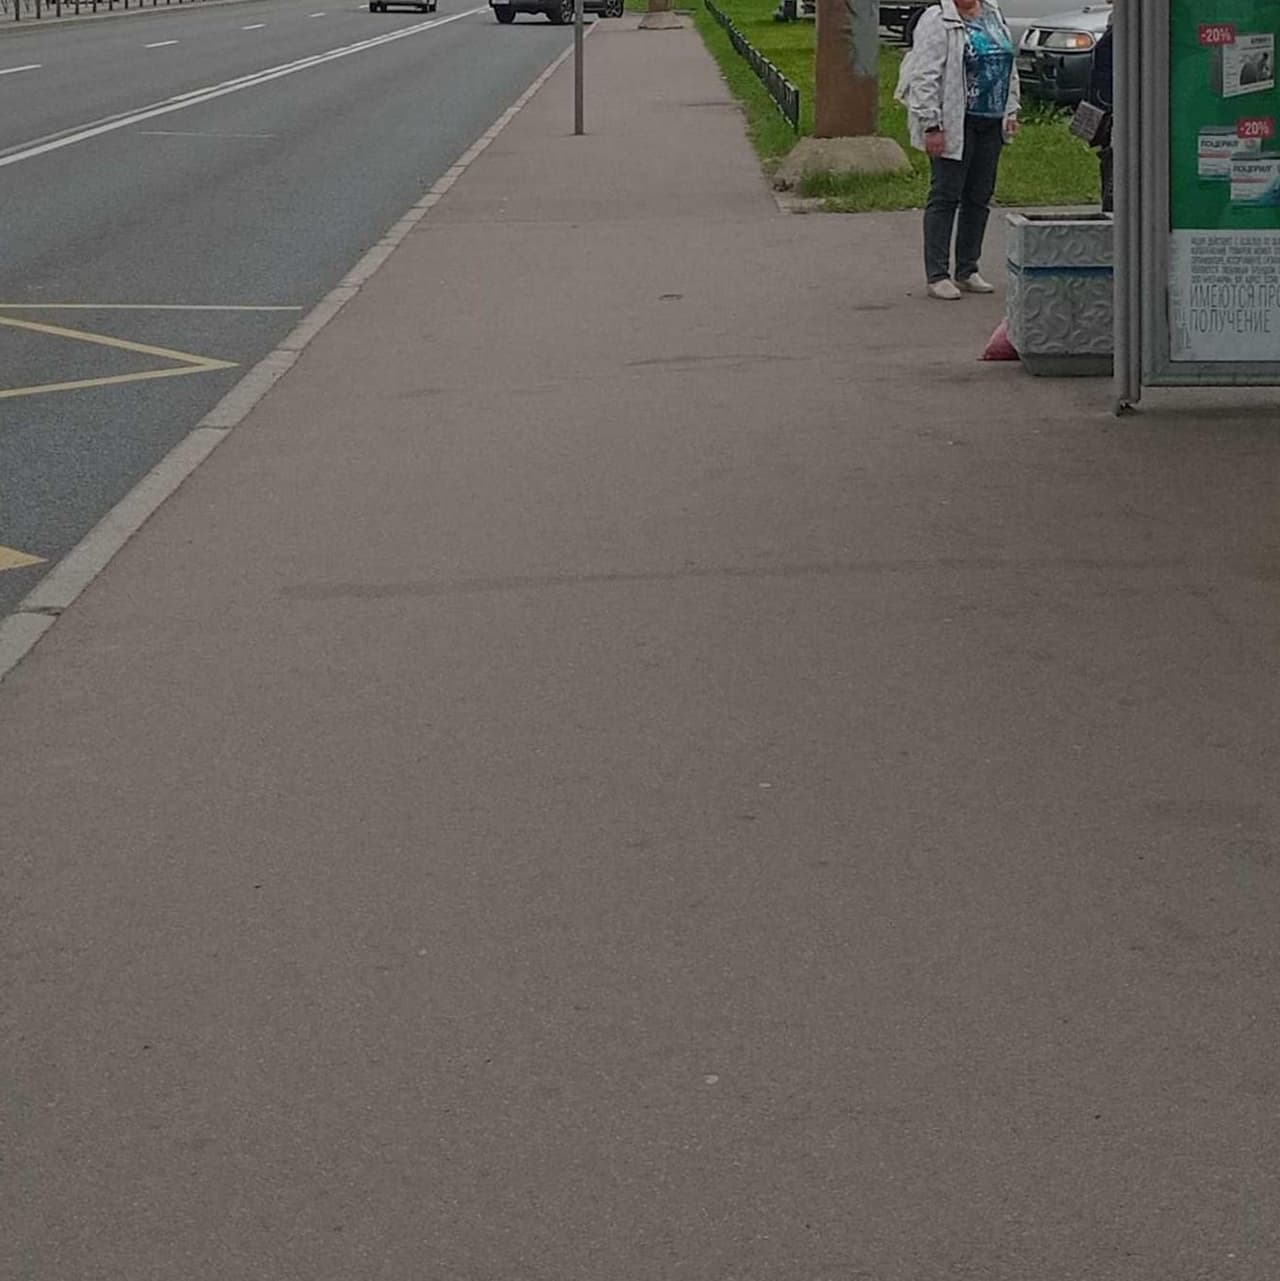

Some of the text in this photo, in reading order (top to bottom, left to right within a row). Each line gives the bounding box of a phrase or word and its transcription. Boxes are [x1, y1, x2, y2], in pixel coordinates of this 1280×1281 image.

[1200, 27, 1233, 43] -20%
[1239, 122, 1270, 137] -20%
[1190, 284, 1255, 308] ИМЕЮТСЯ
[1190, 308, 1272, 333] ПОЛУЧЕНИЕ
